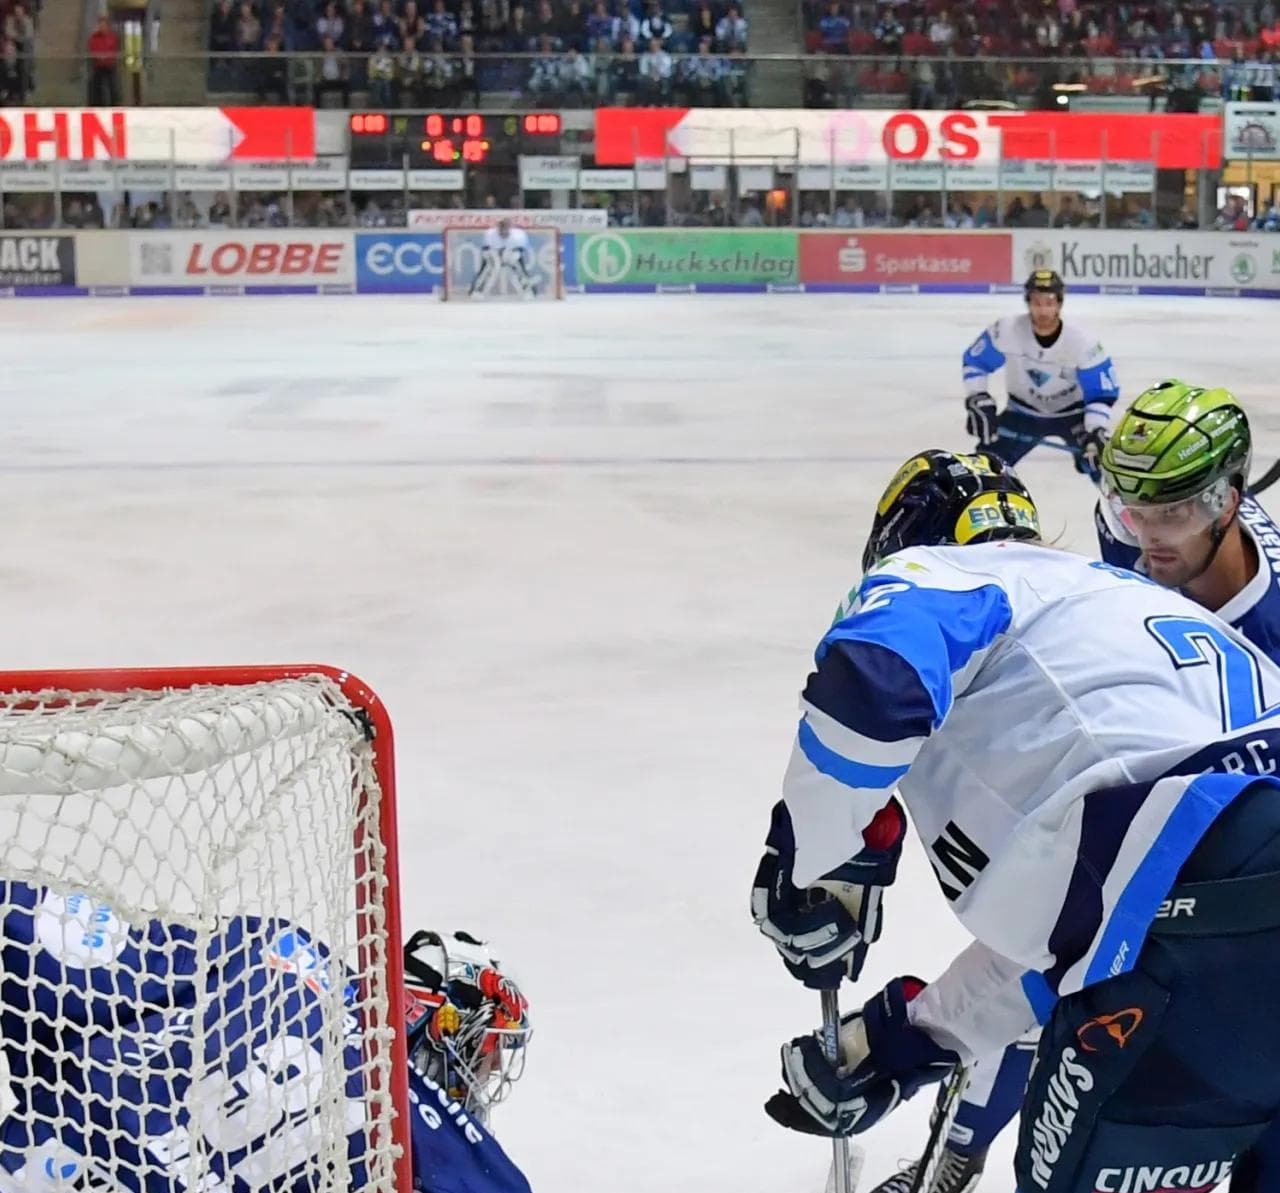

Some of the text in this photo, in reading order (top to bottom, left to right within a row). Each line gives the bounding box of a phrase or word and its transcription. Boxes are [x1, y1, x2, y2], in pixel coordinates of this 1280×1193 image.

[186, 243, 344, 274] LOBBE
[635, 251, 796, 278] Huckschlag
[875, 252, 972, 276] Sparkasse
[1061, 242, 1215, 280] Krombacher
[967, 505, 1040, 526] EDKA
